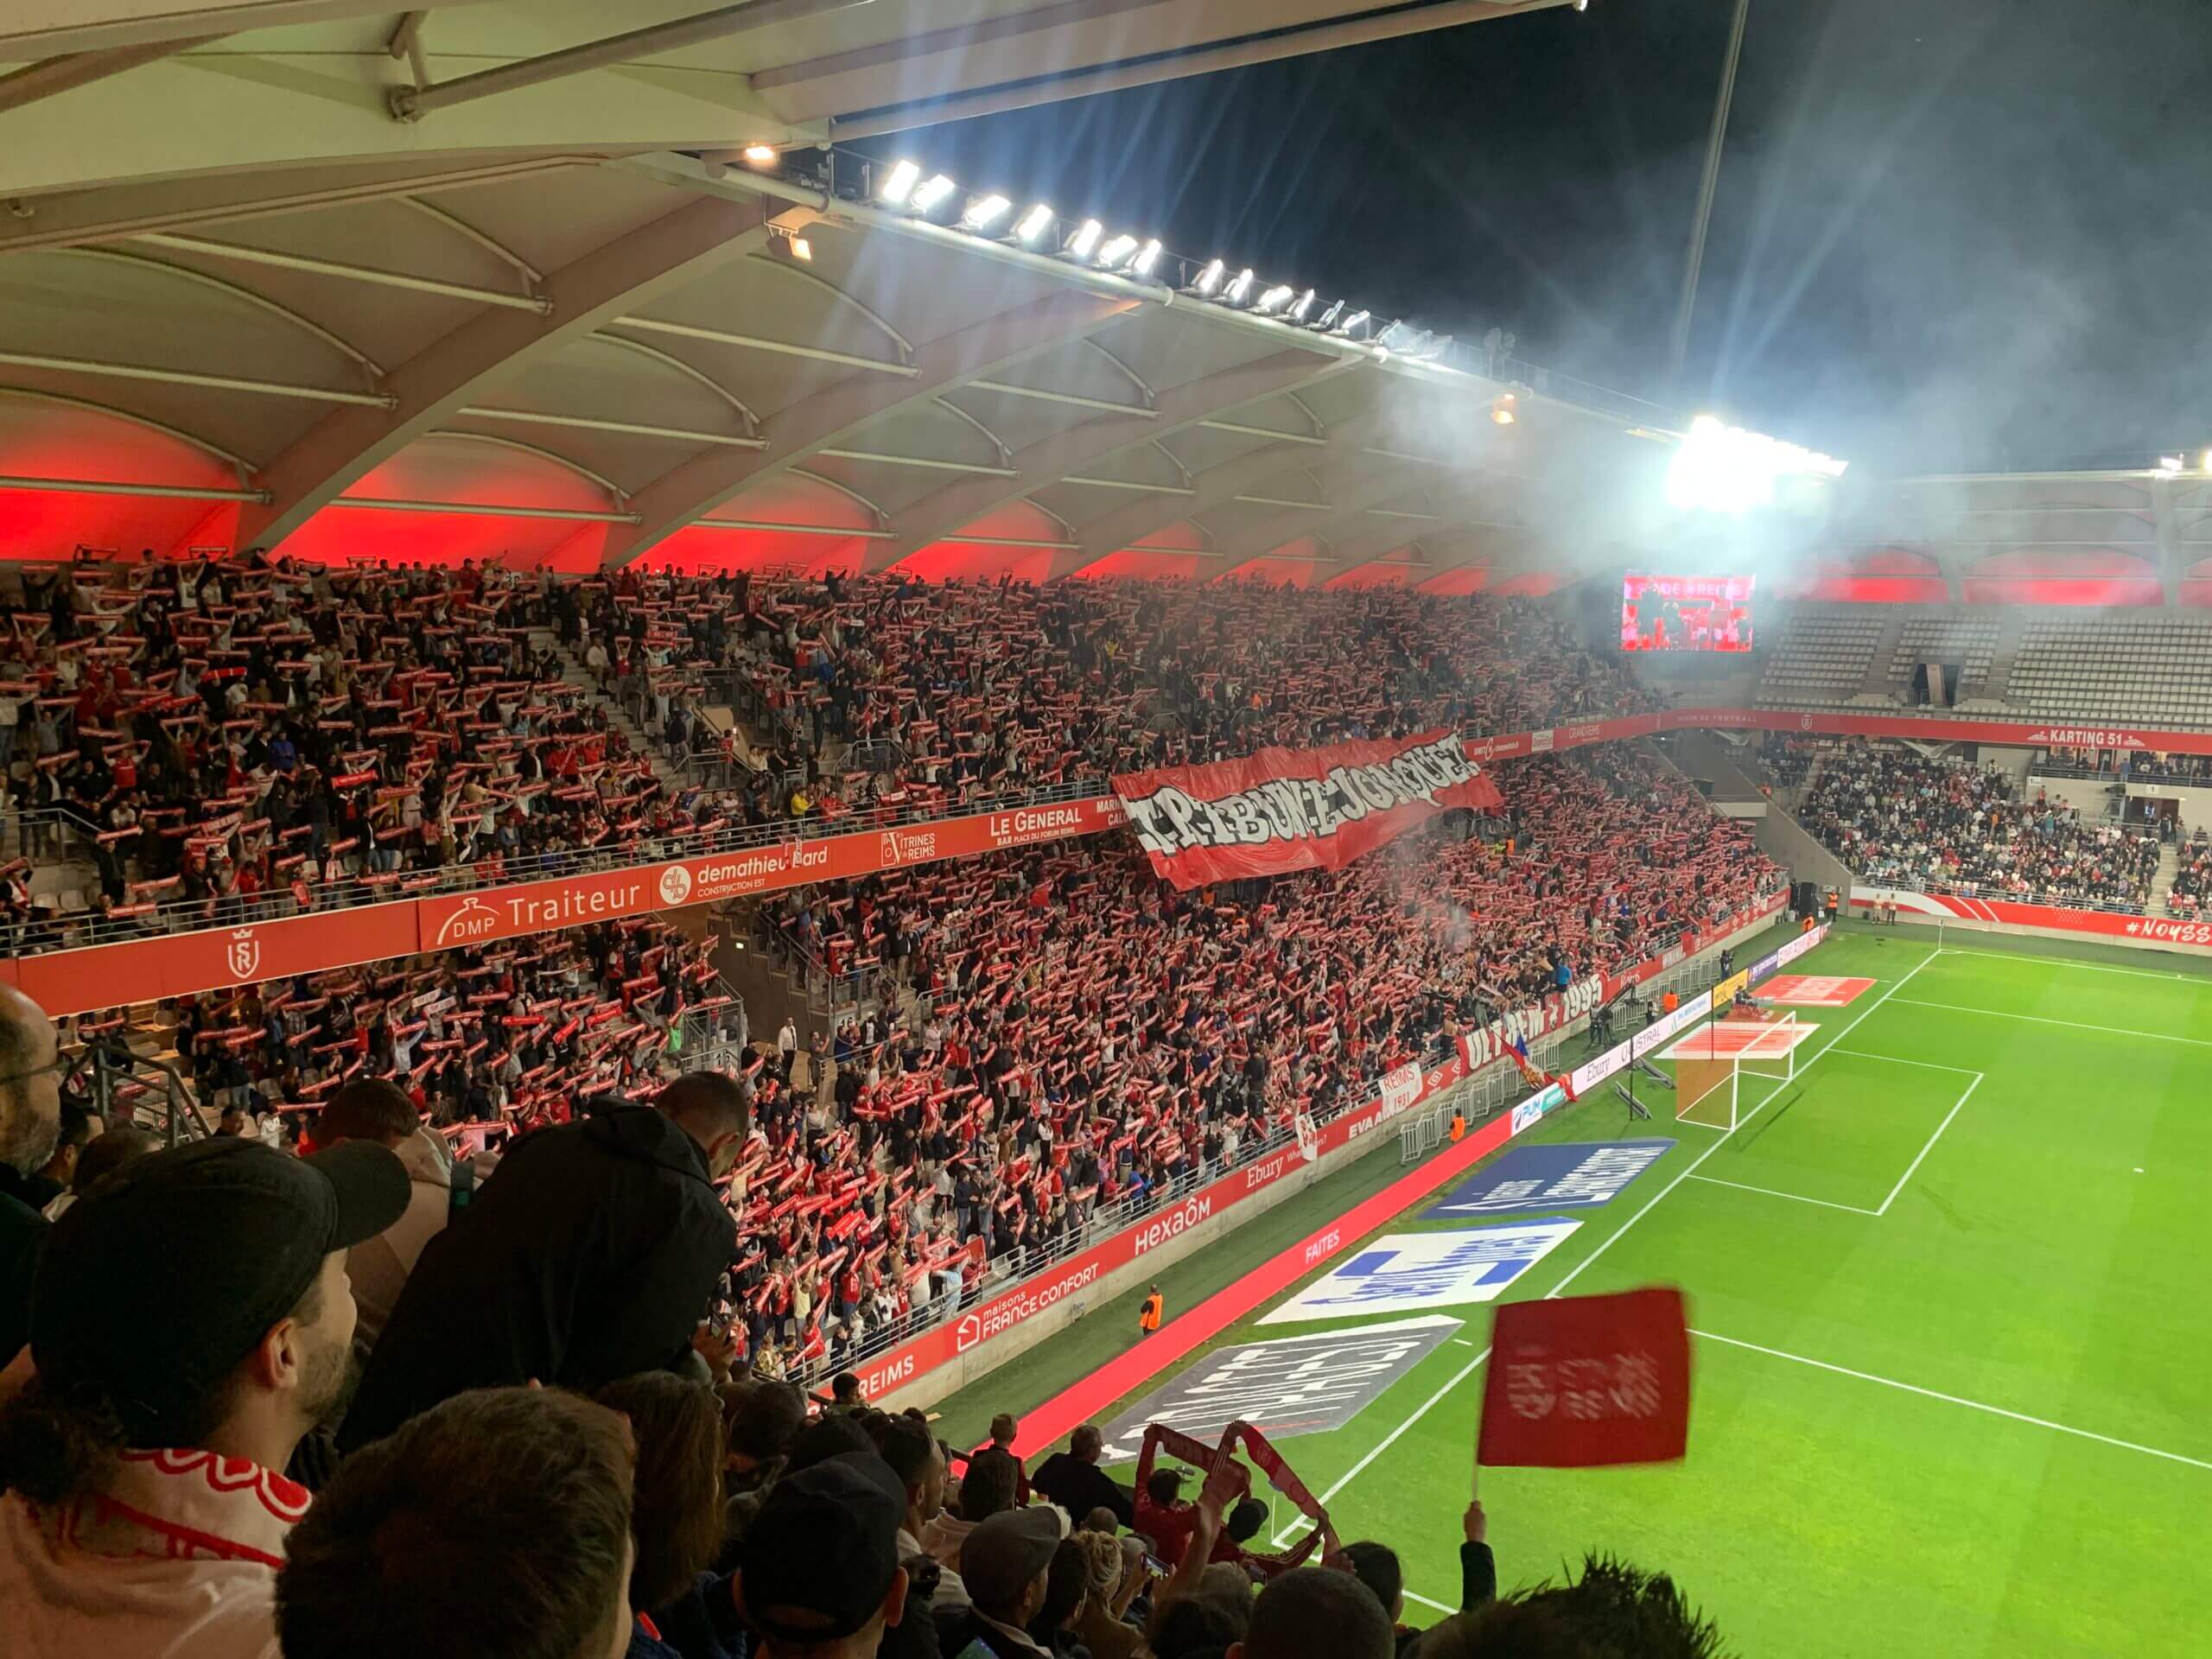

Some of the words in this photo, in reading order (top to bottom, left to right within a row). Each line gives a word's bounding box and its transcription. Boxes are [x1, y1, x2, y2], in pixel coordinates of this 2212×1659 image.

[2050, 729, 2104, 746] KARTING
[2107, 732, 2122, 746] 51
[1096, 798, 1122, 814] MARN
[990, 816, 1010, 837] LE
[1014, 807, 1083, 833] GENERAL
[996, 836, 1013, 847] BAR
[1014, 833, 1030, 843] PLACE
[1031, 832, 1039, 841] DU
[1039, 829, 1060, 839] FORUM
[1060, 826, 1076, 836] REIMS
[908, 844, 936, 861] REIMS
[697, 880, 753, 898] CONSTRUCTION
[753, 878, 766, 888] EST
[506, 884, 641, 926] Traiteur
[453, 916, 495, 938] DMP
[1561, 974, 1603, 1023] 1995
[1382, 1064, 1415, 1093] REIMS
[1246, 1156, 1285, 1189] Ebury
[1305, 1229, 1340, 1265] FAITES
[982, 1298, 1038, 1336] FRANCE
[1039, 1262, 1100, 1309] CONFORT
[982, 1290, 1027, 1321] maisons
